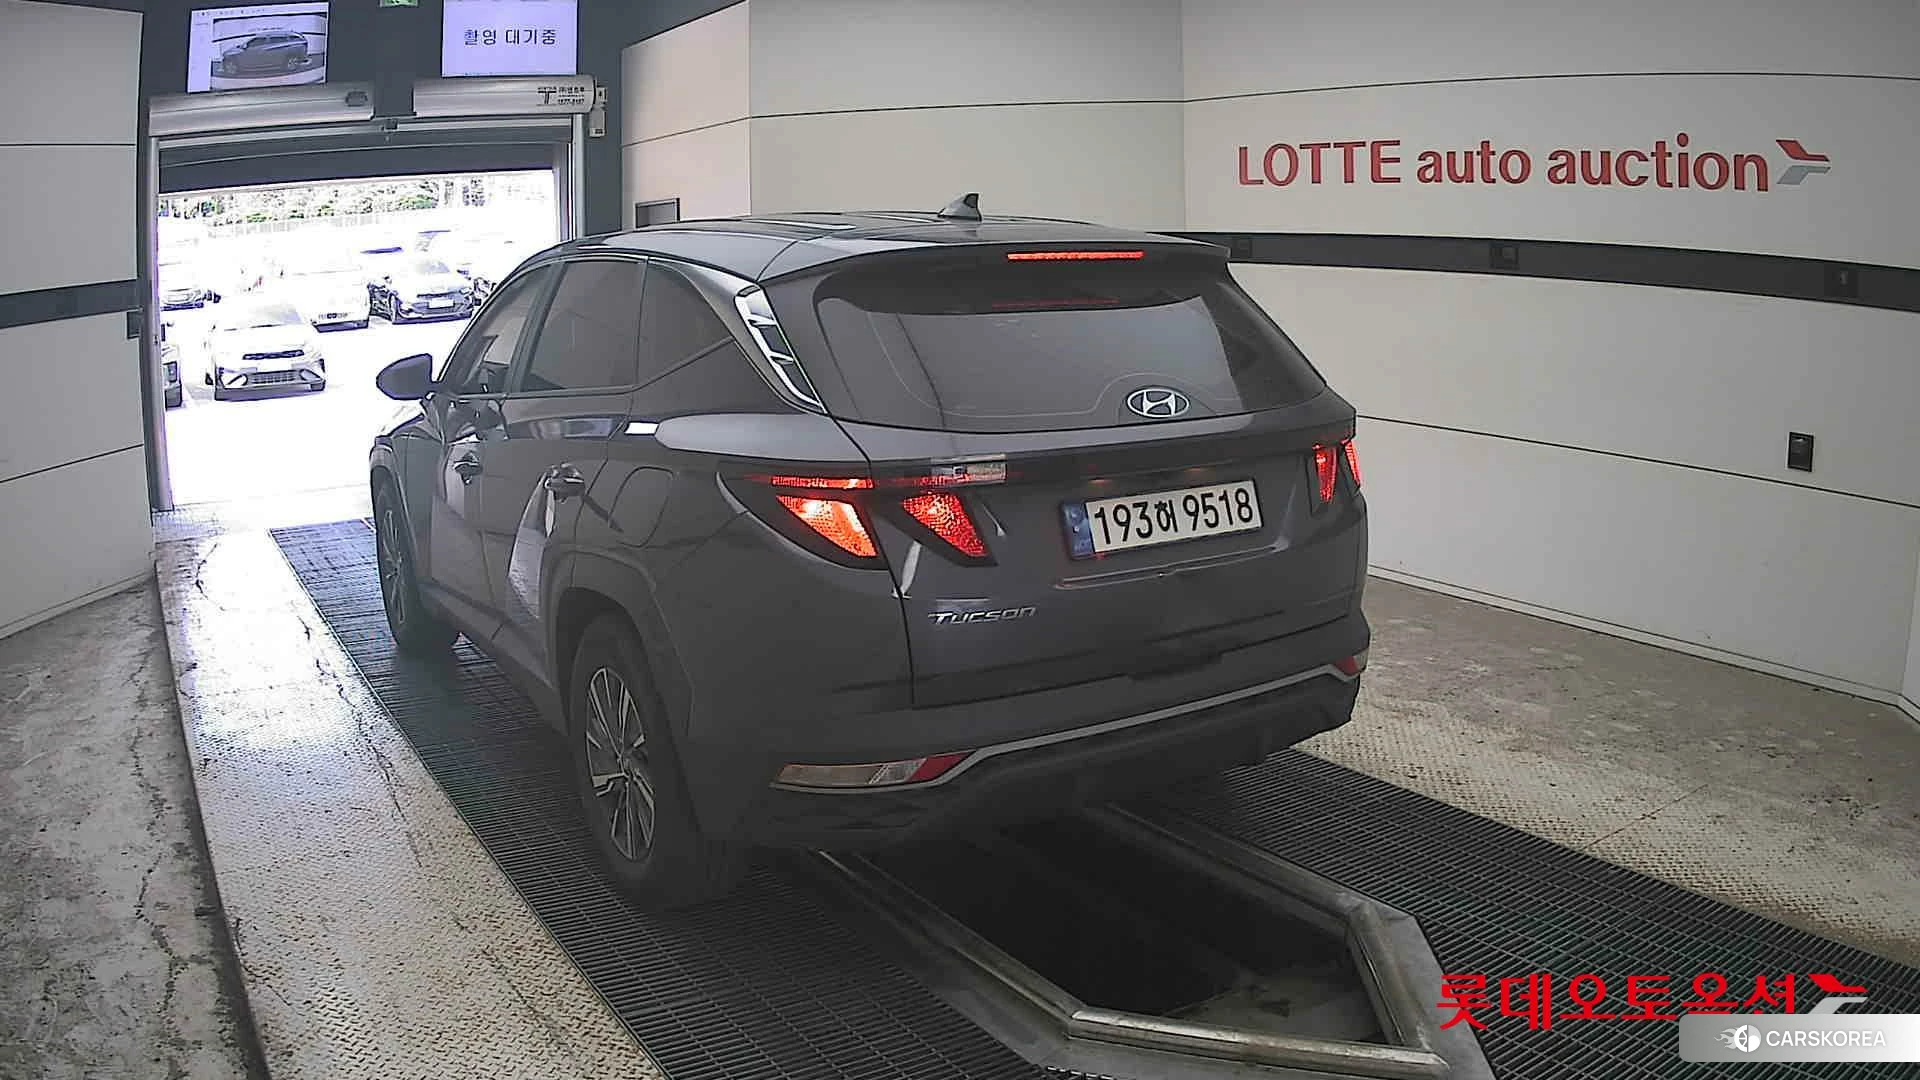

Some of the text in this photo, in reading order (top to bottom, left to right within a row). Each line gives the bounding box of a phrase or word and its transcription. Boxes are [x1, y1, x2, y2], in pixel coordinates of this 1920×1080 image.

[464, 28, 557, 46] 촬영 대기중
[1239, 133, 1769, 191] LOTTE auto auction
